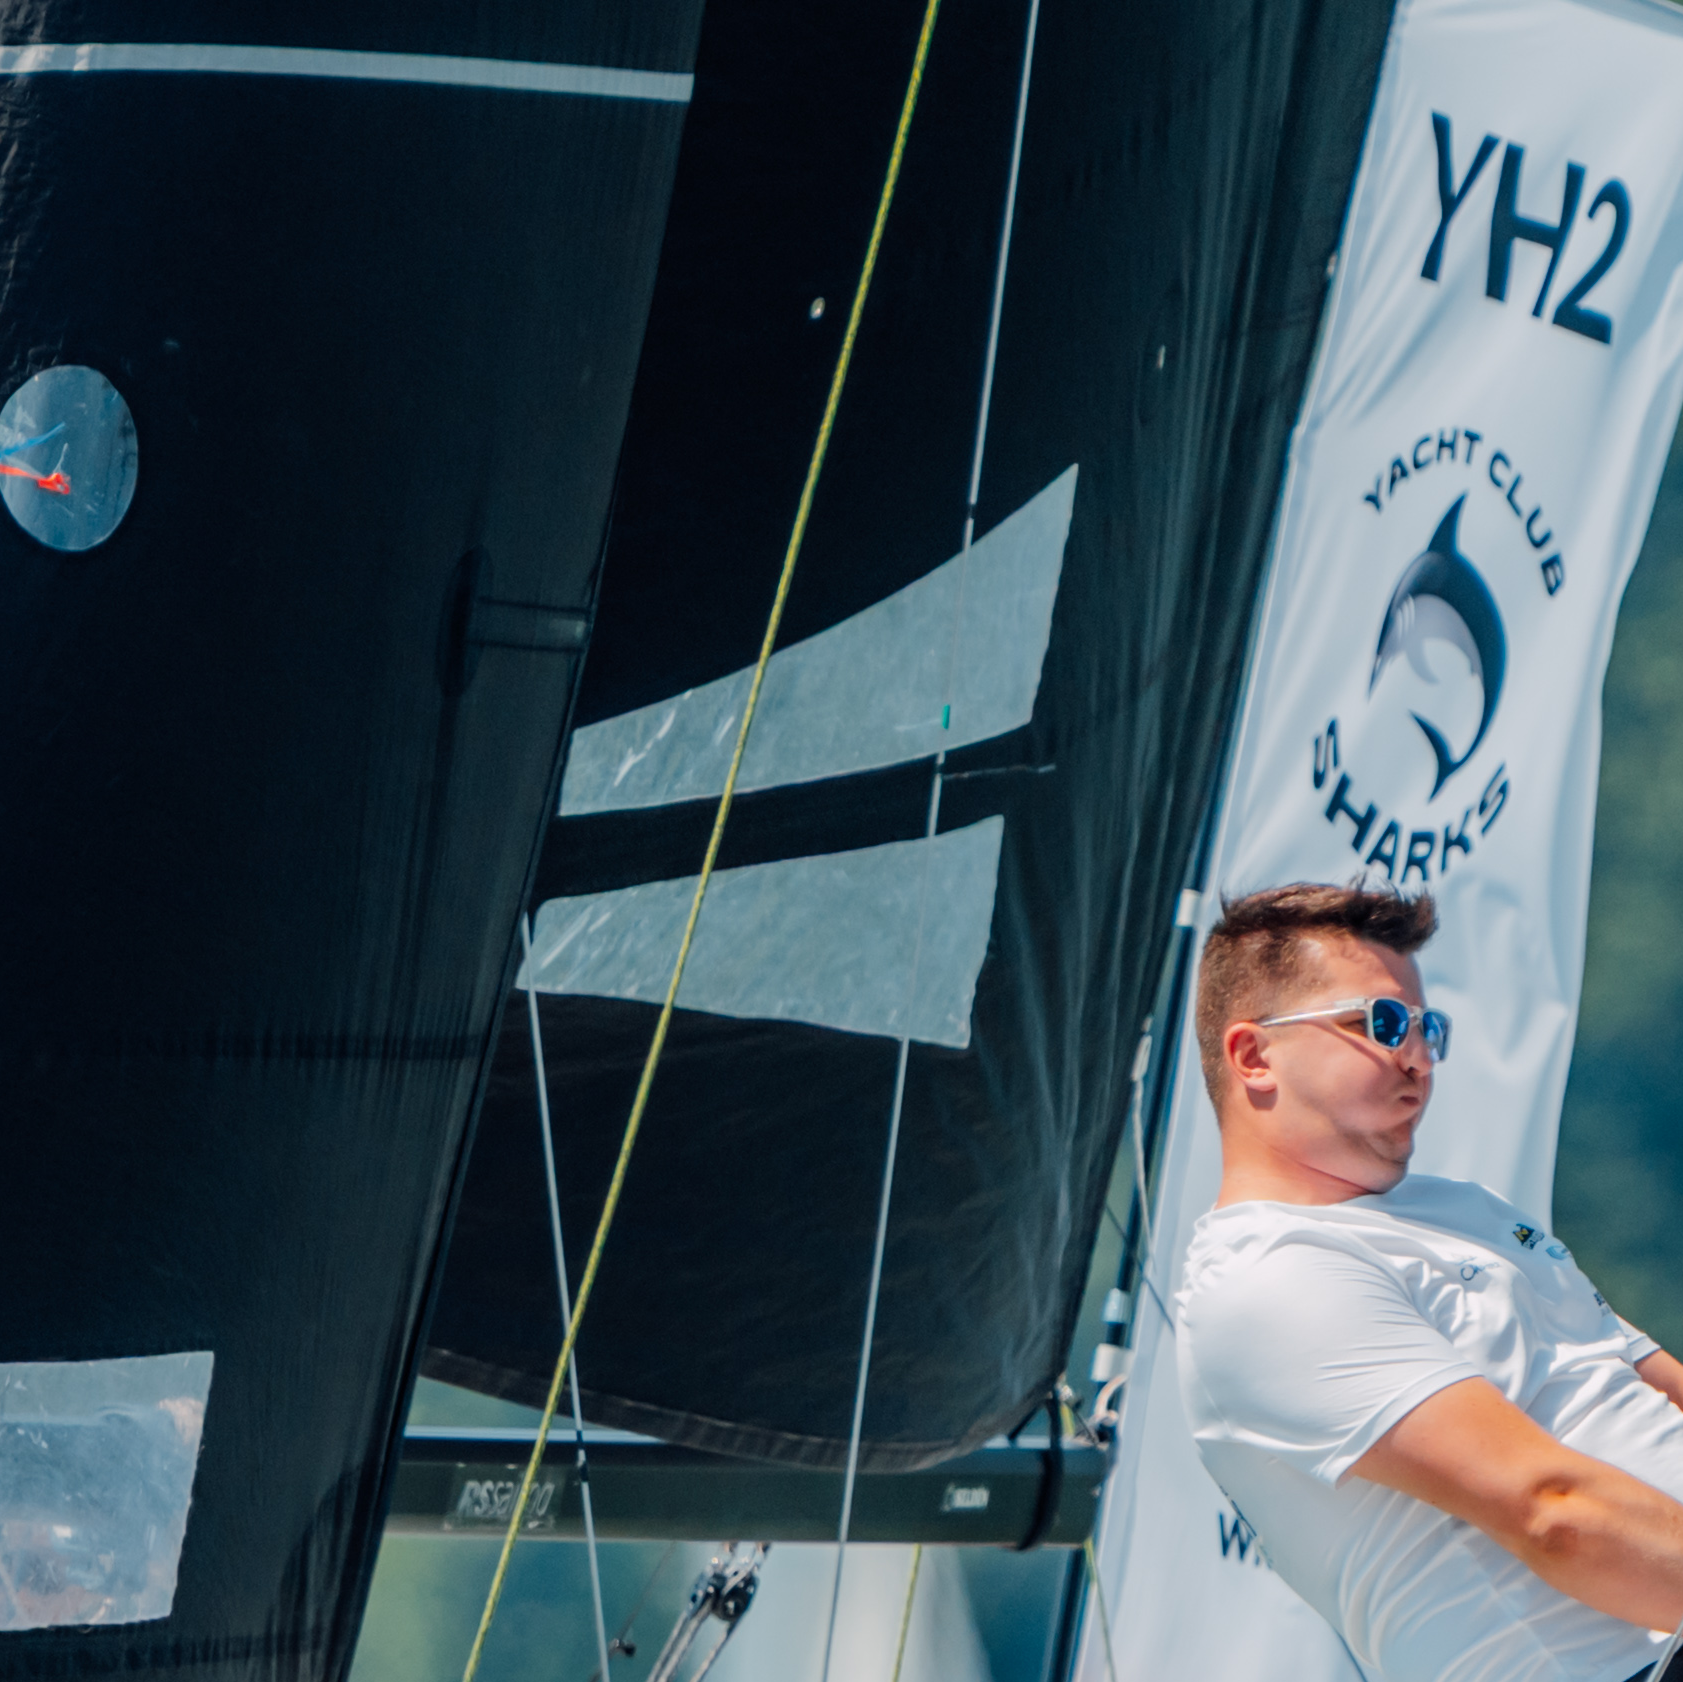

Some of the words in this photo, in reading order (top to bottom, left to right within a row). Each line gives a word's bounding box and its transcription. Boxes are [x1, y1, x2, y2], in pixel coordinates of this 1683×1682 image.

[1419, 109, 1633, 346] YH2
[1360, 426, 1483, 515] YACHT
[1489, 451, 1564, 600] CLUB
[1312, 716, 1512, 884] SHARKS
